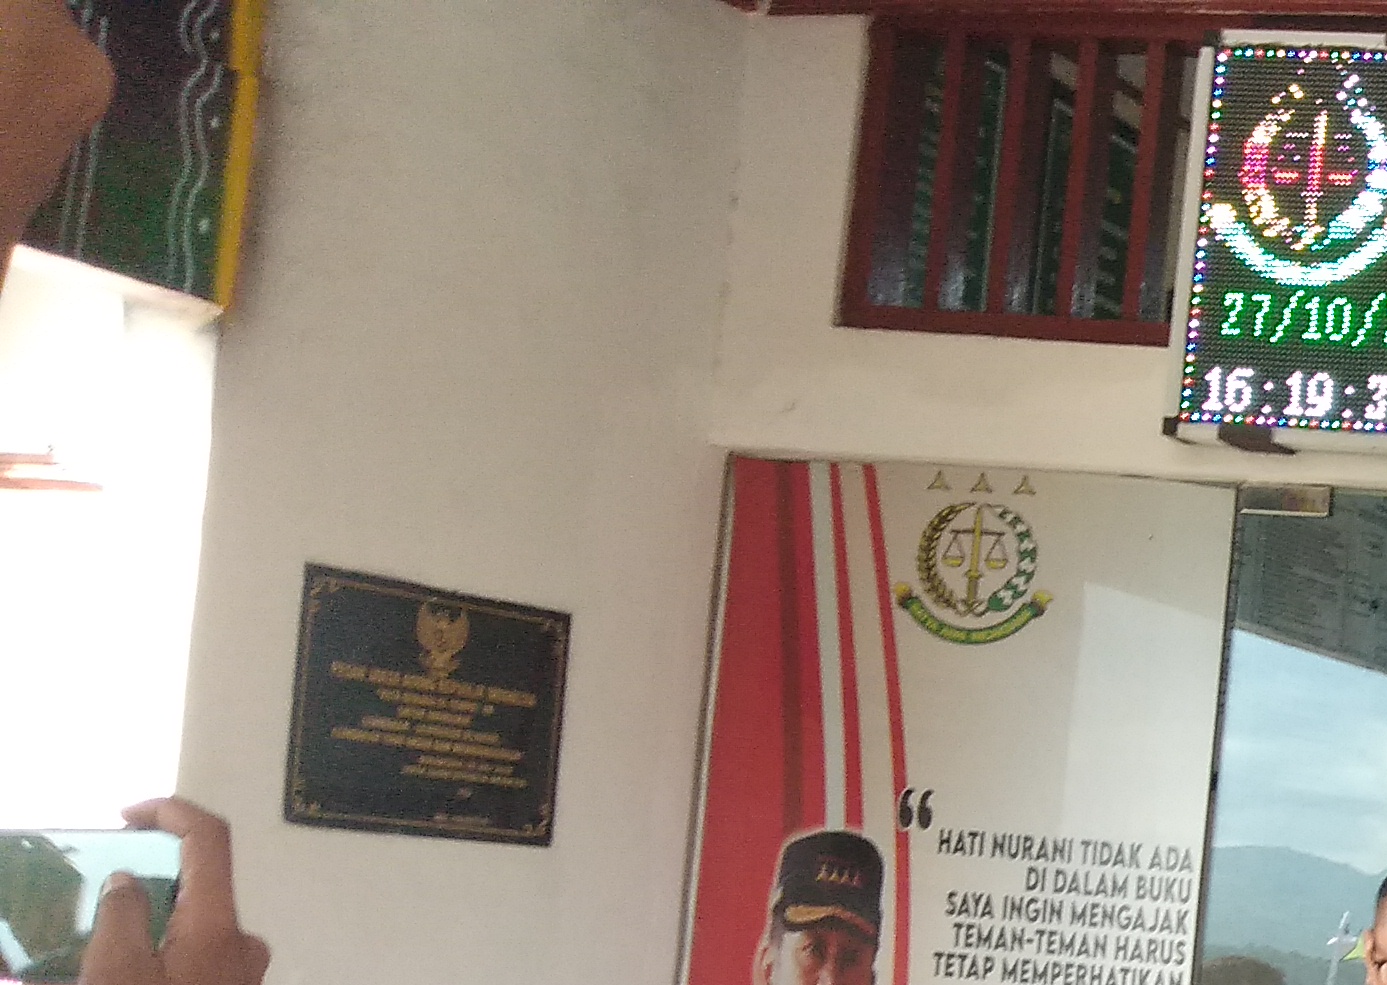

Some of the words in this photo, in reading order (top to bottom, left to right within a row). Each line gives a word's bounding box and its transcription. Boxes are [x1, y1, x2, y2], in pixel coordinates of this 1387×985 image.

[937, 829, 984, 857] HATI
[991, 833, 1073, 864] NURANI
[1081, 840, 1143, 869] TIDAK
[1149, 846, 1193, 873] ADA
[1025, 867, 1048, 892] DI
[1054, 870, 1127, 898] DALAM
[1136, 874, 1192, 903] BUKU
[945, 891, 994, 918] SAYA
[1003, 895, 1062, 923] INGIN
[1070, 901, 1190, 935] MENGAJAK
[953, 923, 1107, 960] TEMAN-TEMAN
[1115, 935, 1187, 965] HARUS
[933, 952, 994, 980] TETAP
